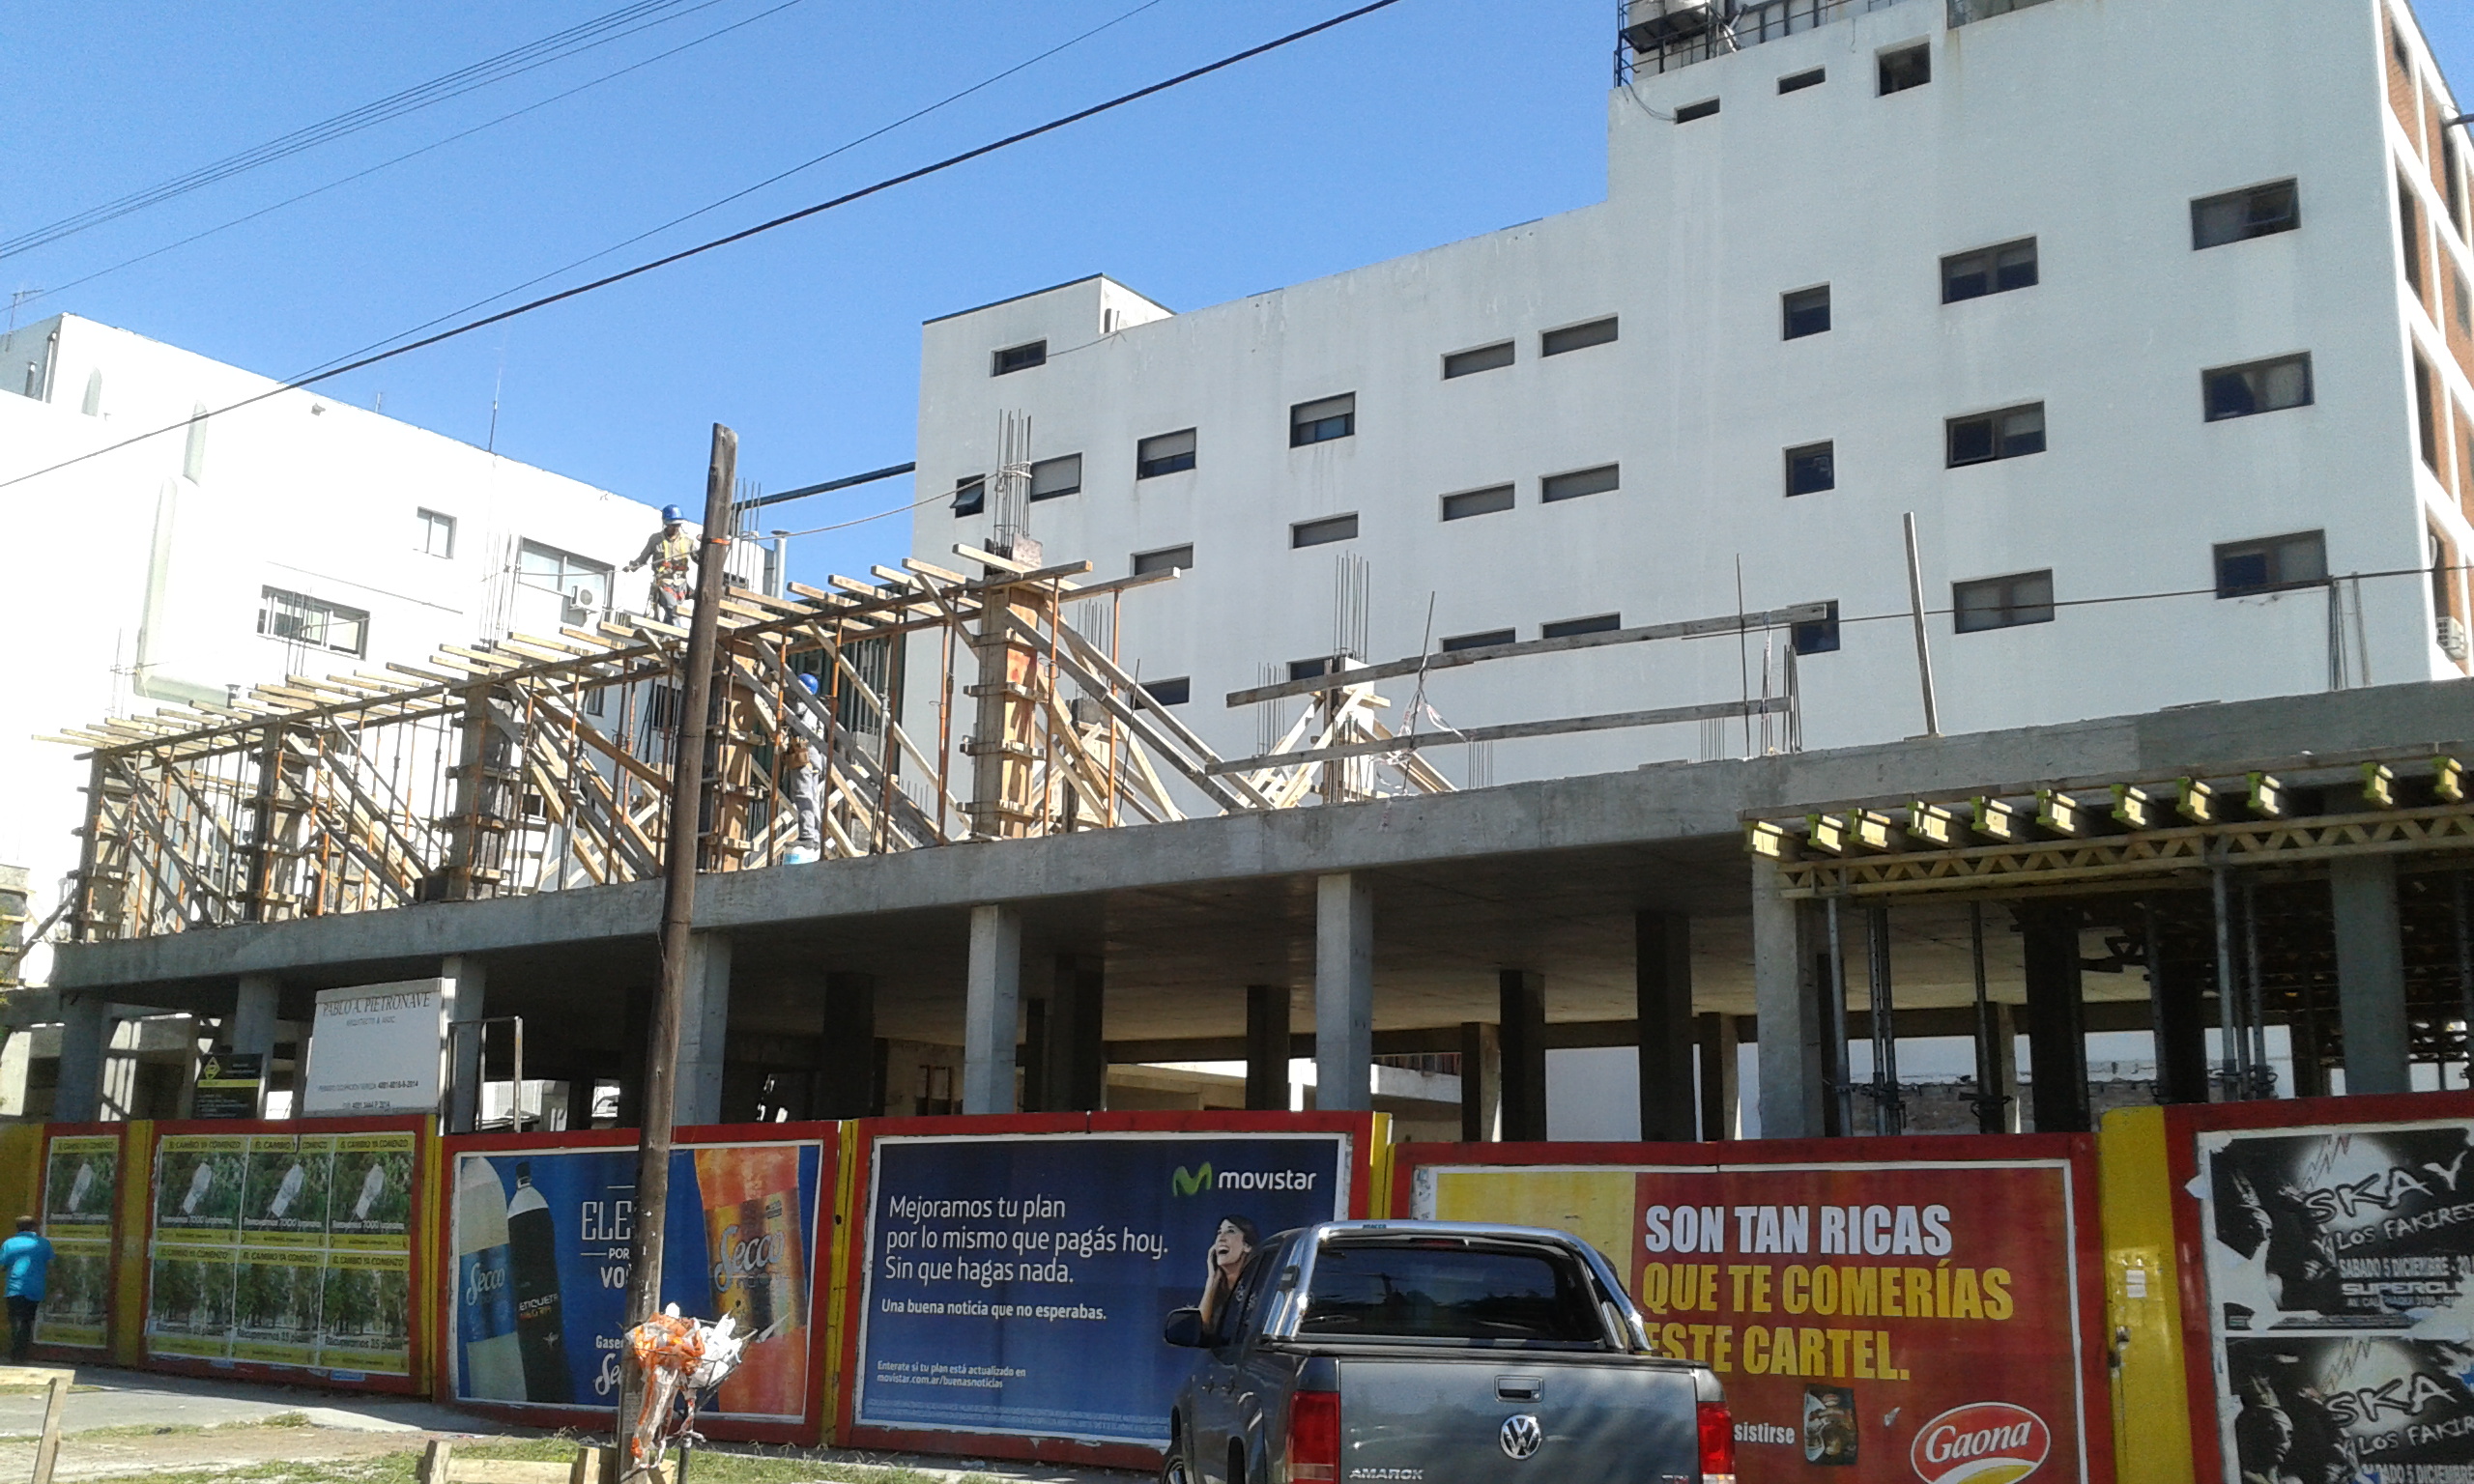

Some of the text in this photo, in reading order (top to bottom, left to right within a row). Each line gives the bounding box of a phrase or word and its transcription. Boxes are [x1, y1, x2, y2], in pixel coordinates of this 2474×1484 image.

[322, 1001, 351, 1016] PABLO
[363, 992, 430, 1013] PIETRONAVE
[1218, 1169, 1317, 1191] movistar
[581, 1201, 632, 1241] ELE
[889, 1193, 1066, 1225] Mejoramos tu plan
[886, 1224, 1168, 1260] por lo mismo que pagás hoy.
[1645, 1204, 1953, 1256] SON TAN RICAS
[2335, 1225, 2376, 1250] LOS
[608, 1247, 630, 1260] POR
[714, 1224, 786, 1293] Secco
[466, 1262, 505, 1306] Secco
[885, 1255, 1074, 1288] Sin que hagas nada.
[1643, 1258, 2014, 1321] QUE TE COMERÍAS
[881, 1298, 1107, 1322] Una buena noticia que no esperabas.
[920, 1363, 929, 1373] tu
[931, 1361, 948, 1375] plan
[1015, 1367, 1026, 1378] en
[1742, 1325, 1911, 1382] CARTEL.
[1925, 1420, 2032, 1463] Gaona
[2358, 1432, 2399, 1455] LOS
[1348, 1468, 1424, 1481] AMAROK
